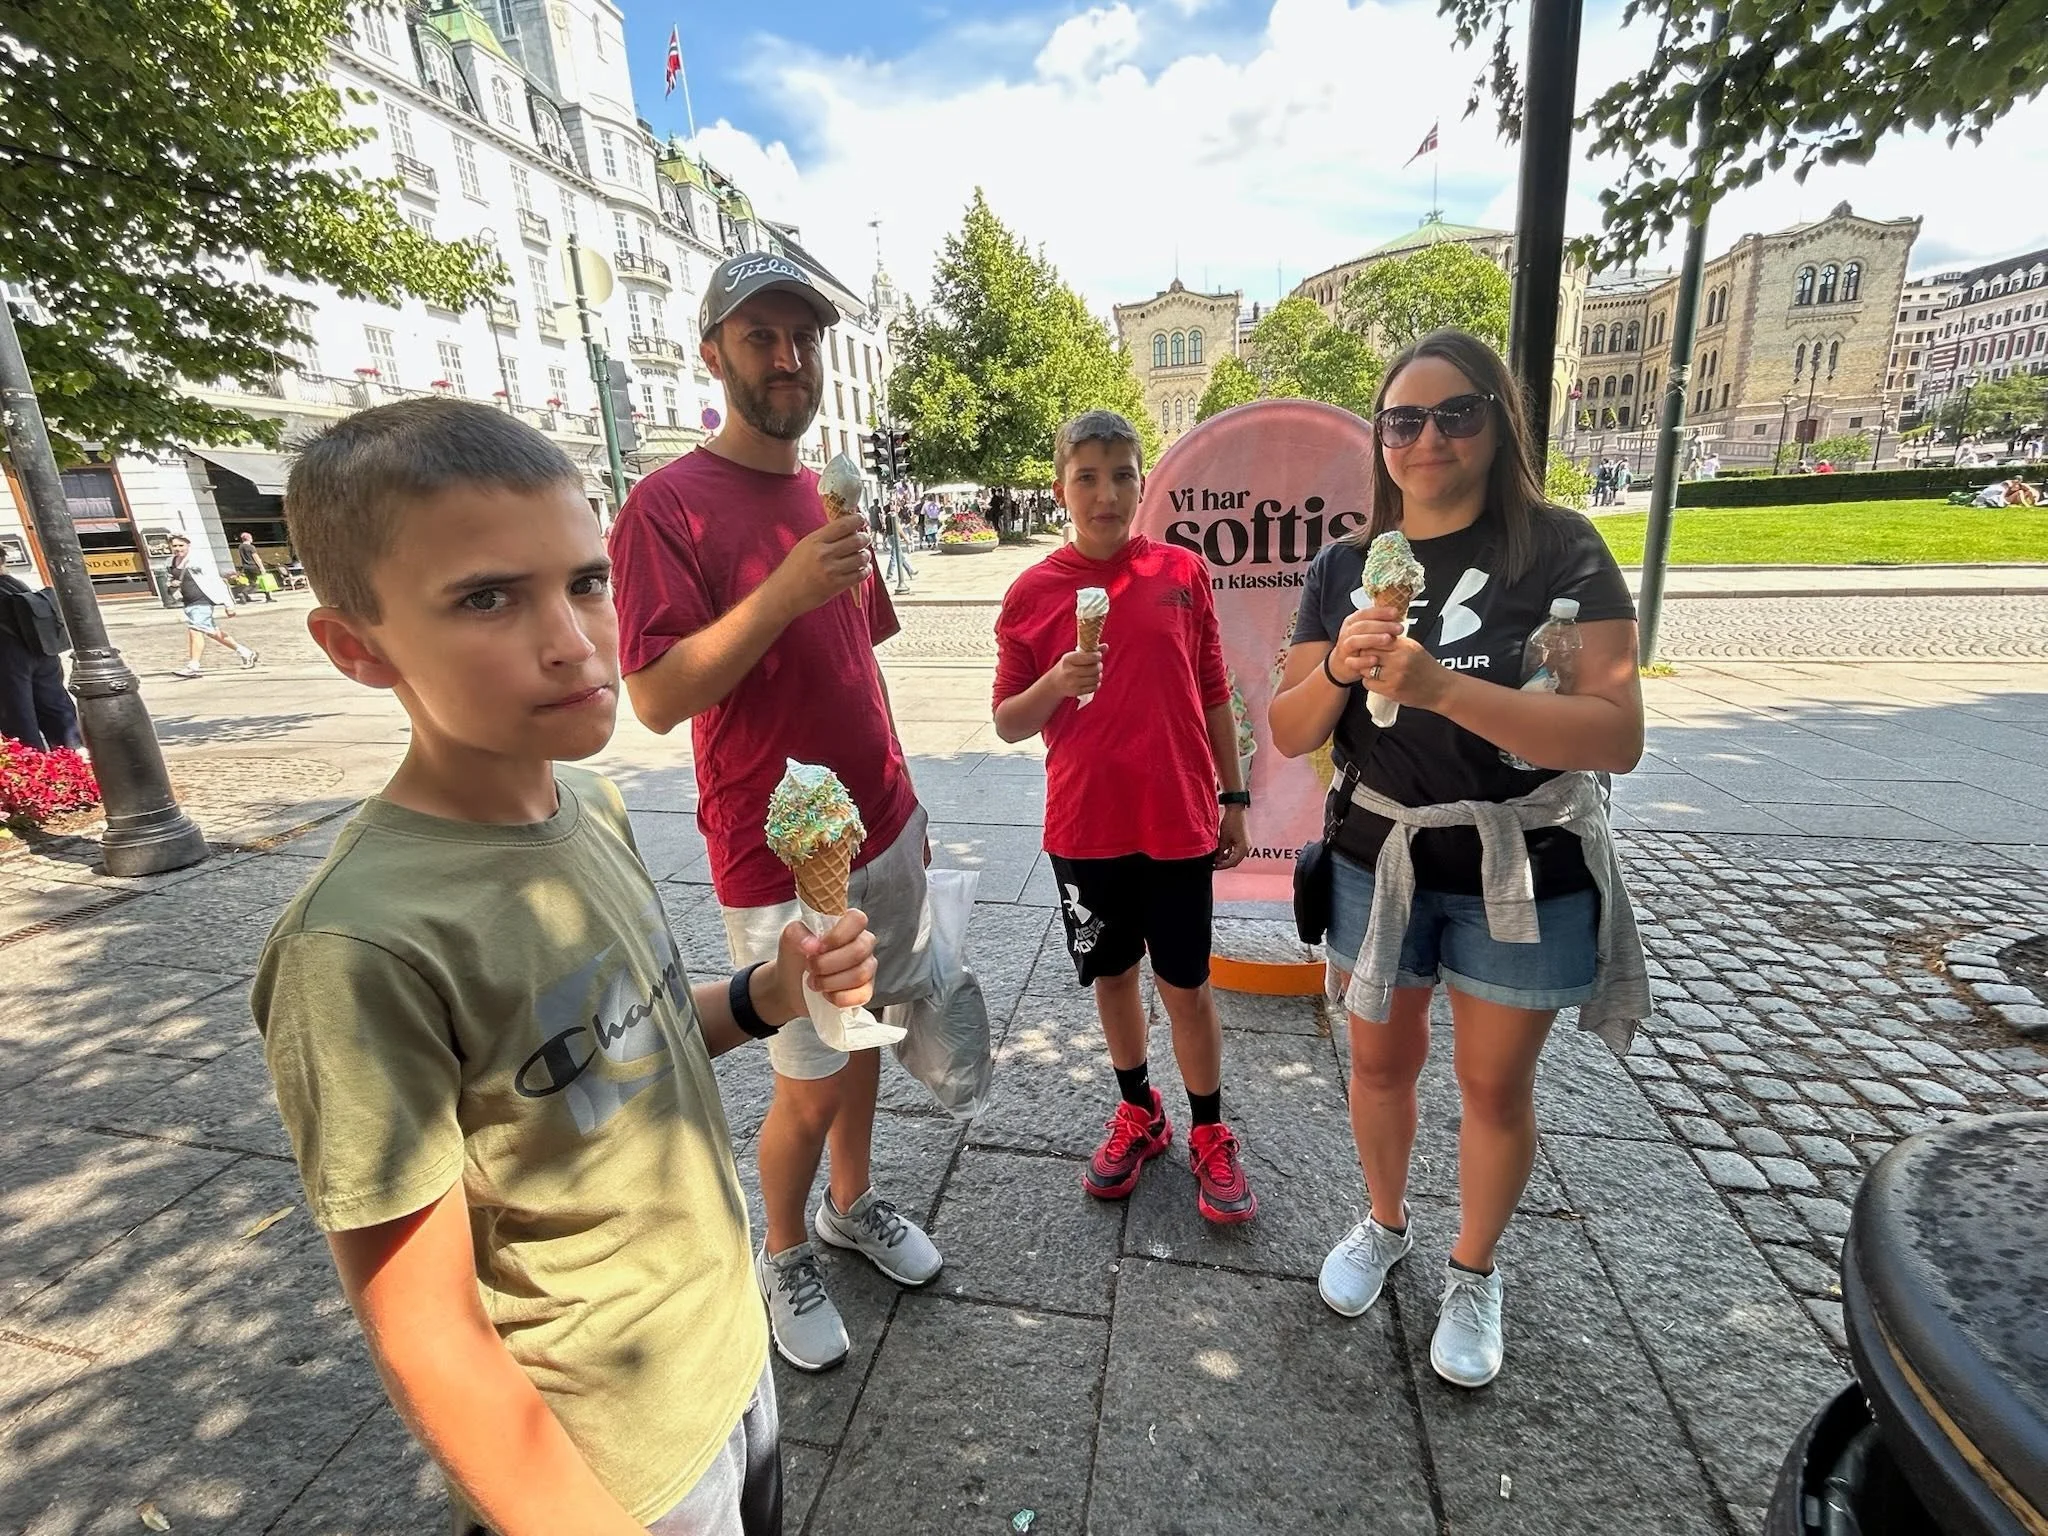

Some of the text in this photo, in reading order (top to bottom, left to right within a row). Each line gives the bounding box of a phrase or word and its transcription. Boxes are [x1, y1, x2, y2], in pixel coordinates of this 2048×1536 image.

[1168, 488, 1251, 512] Vi har
[1245, 846, 1303, 860] ARVES
